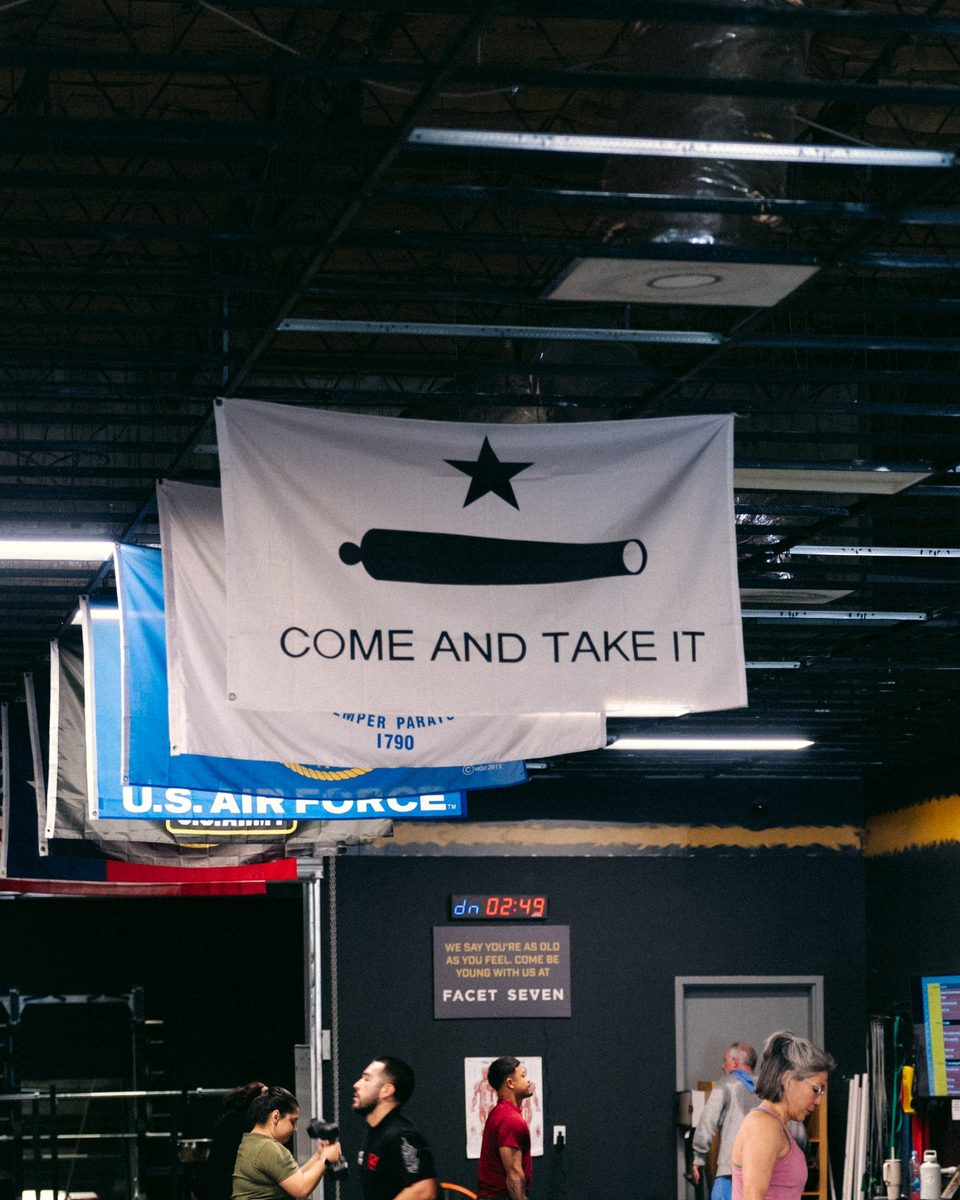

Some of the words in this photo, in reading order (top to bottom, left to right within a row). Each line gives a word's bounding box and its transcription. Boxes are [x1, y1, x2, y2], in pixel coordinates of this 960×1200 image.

[280, 626, 415, 662] COME
[430, 630, 527, 664] AND
[541, 630, 658, 663] TAKE
[673, 631, 706, 663] IT
[333, 711, 386, 730] MPER
[376, 732, 415, 751] 1790
[122, 787, 203, 814] U.S.
[210, 789, 286, 815] AIR
[295, 787, 447, 815] FORCE
[485, 897, 546, 917] 02:49
[445, 943, 462, 952] WE
[463, 942, 483, 952] SAY
[485, 942, 522, 952] YOU'RE
[524, 942, 538, 951] AS
[540, 942, 560, 951] OLD
[445, 956, 460, 965] AS
[462, 956, 483, 965] YOU
[484, 955, 512, 965] FEEL.
[514, 955, 545, 964] COME
[546, 955, 560, 964] BE
[456, 968, 491, 978] YOUNG
[493, 968, 520, 977] WITH
[522, 968, 536, 977] US
[538, 968, 551, 977] AT
[443, 988, 498, 1002] FACET
[507, 987, 565, 1001] SEVEN
